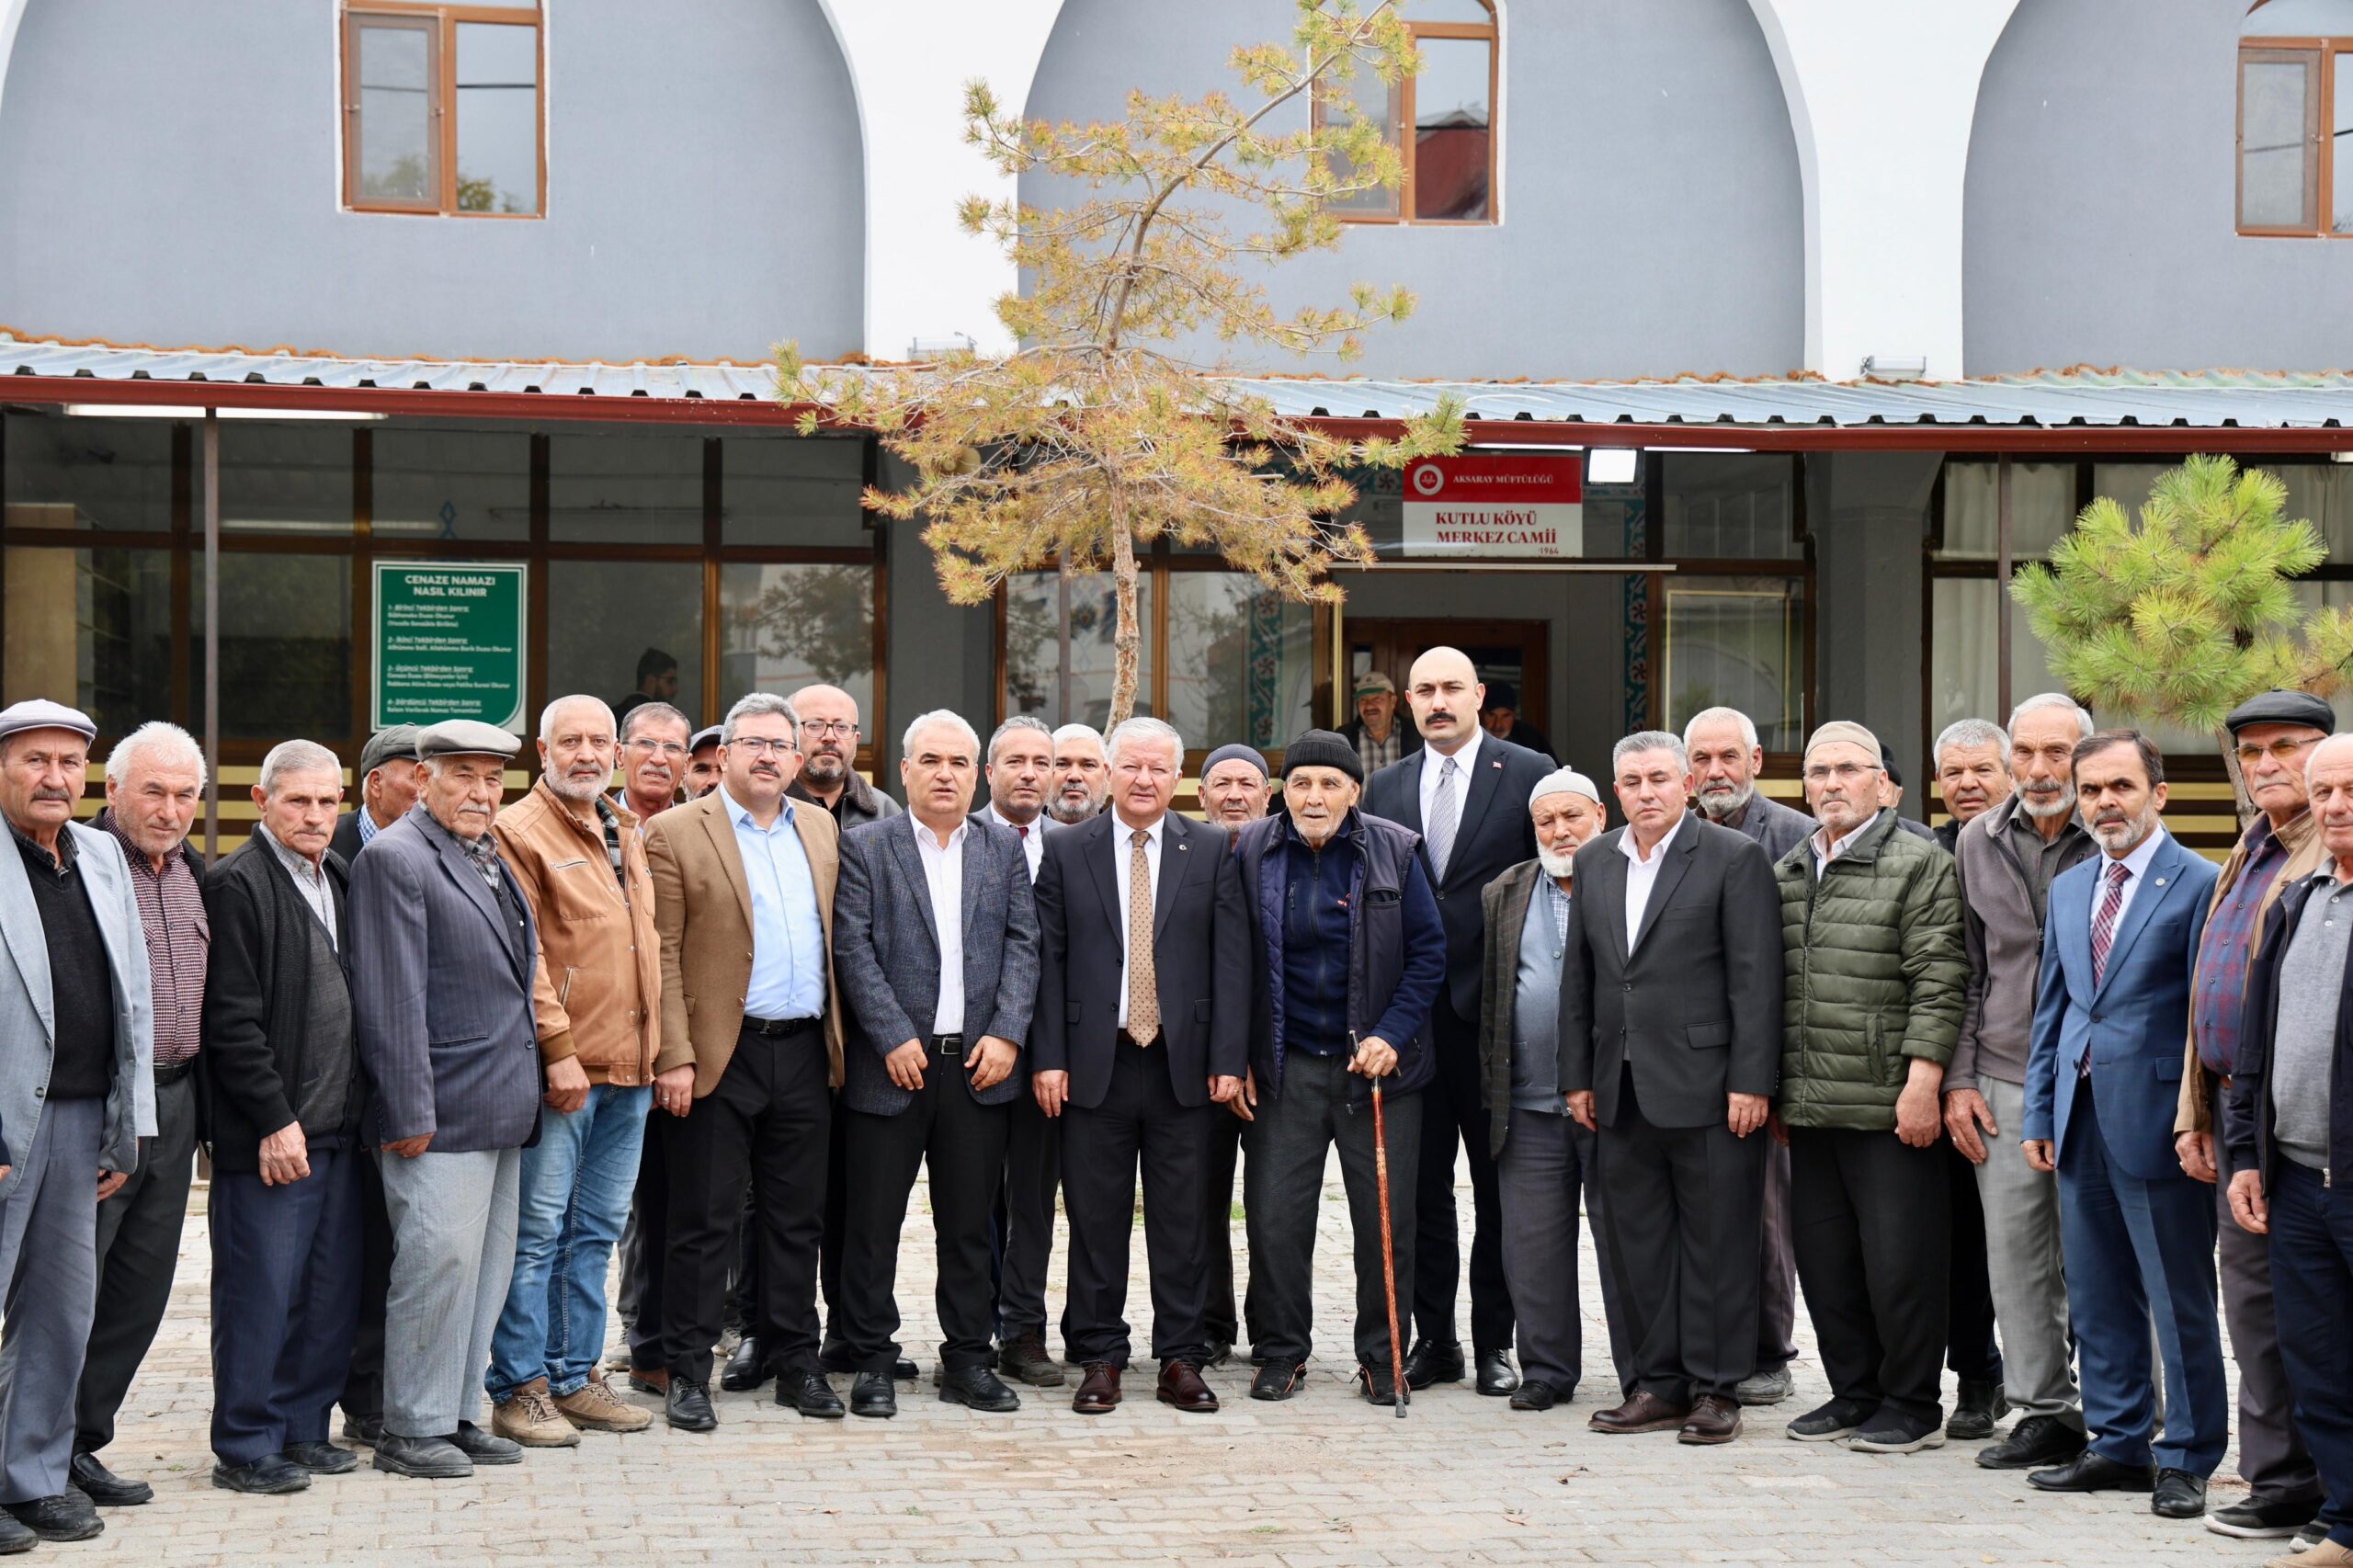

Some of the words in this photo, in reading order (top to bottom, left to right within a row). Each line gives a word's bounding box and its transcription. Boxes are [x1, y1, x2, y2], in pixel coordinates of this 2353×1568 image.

[1453, 475, 1493, 484] AKSARAY
[1495, 473, 1553, 484] MÜFTÜLÜĞÜ
[1436, 512, 1490, 526] KUTLU
[1494, 510, 1537, 526] KÖYÜ
[1437, 531, 1505, 543] MERKEZ
[1507, 528, 1556, 544] CAMİİ
[404, 575, 449, 585] CENAZE
[451, 575, 495, 585] NAMAZI
[414, 586, 446, 597] NASIL
[449, 587, 487, 597] KILINIR
